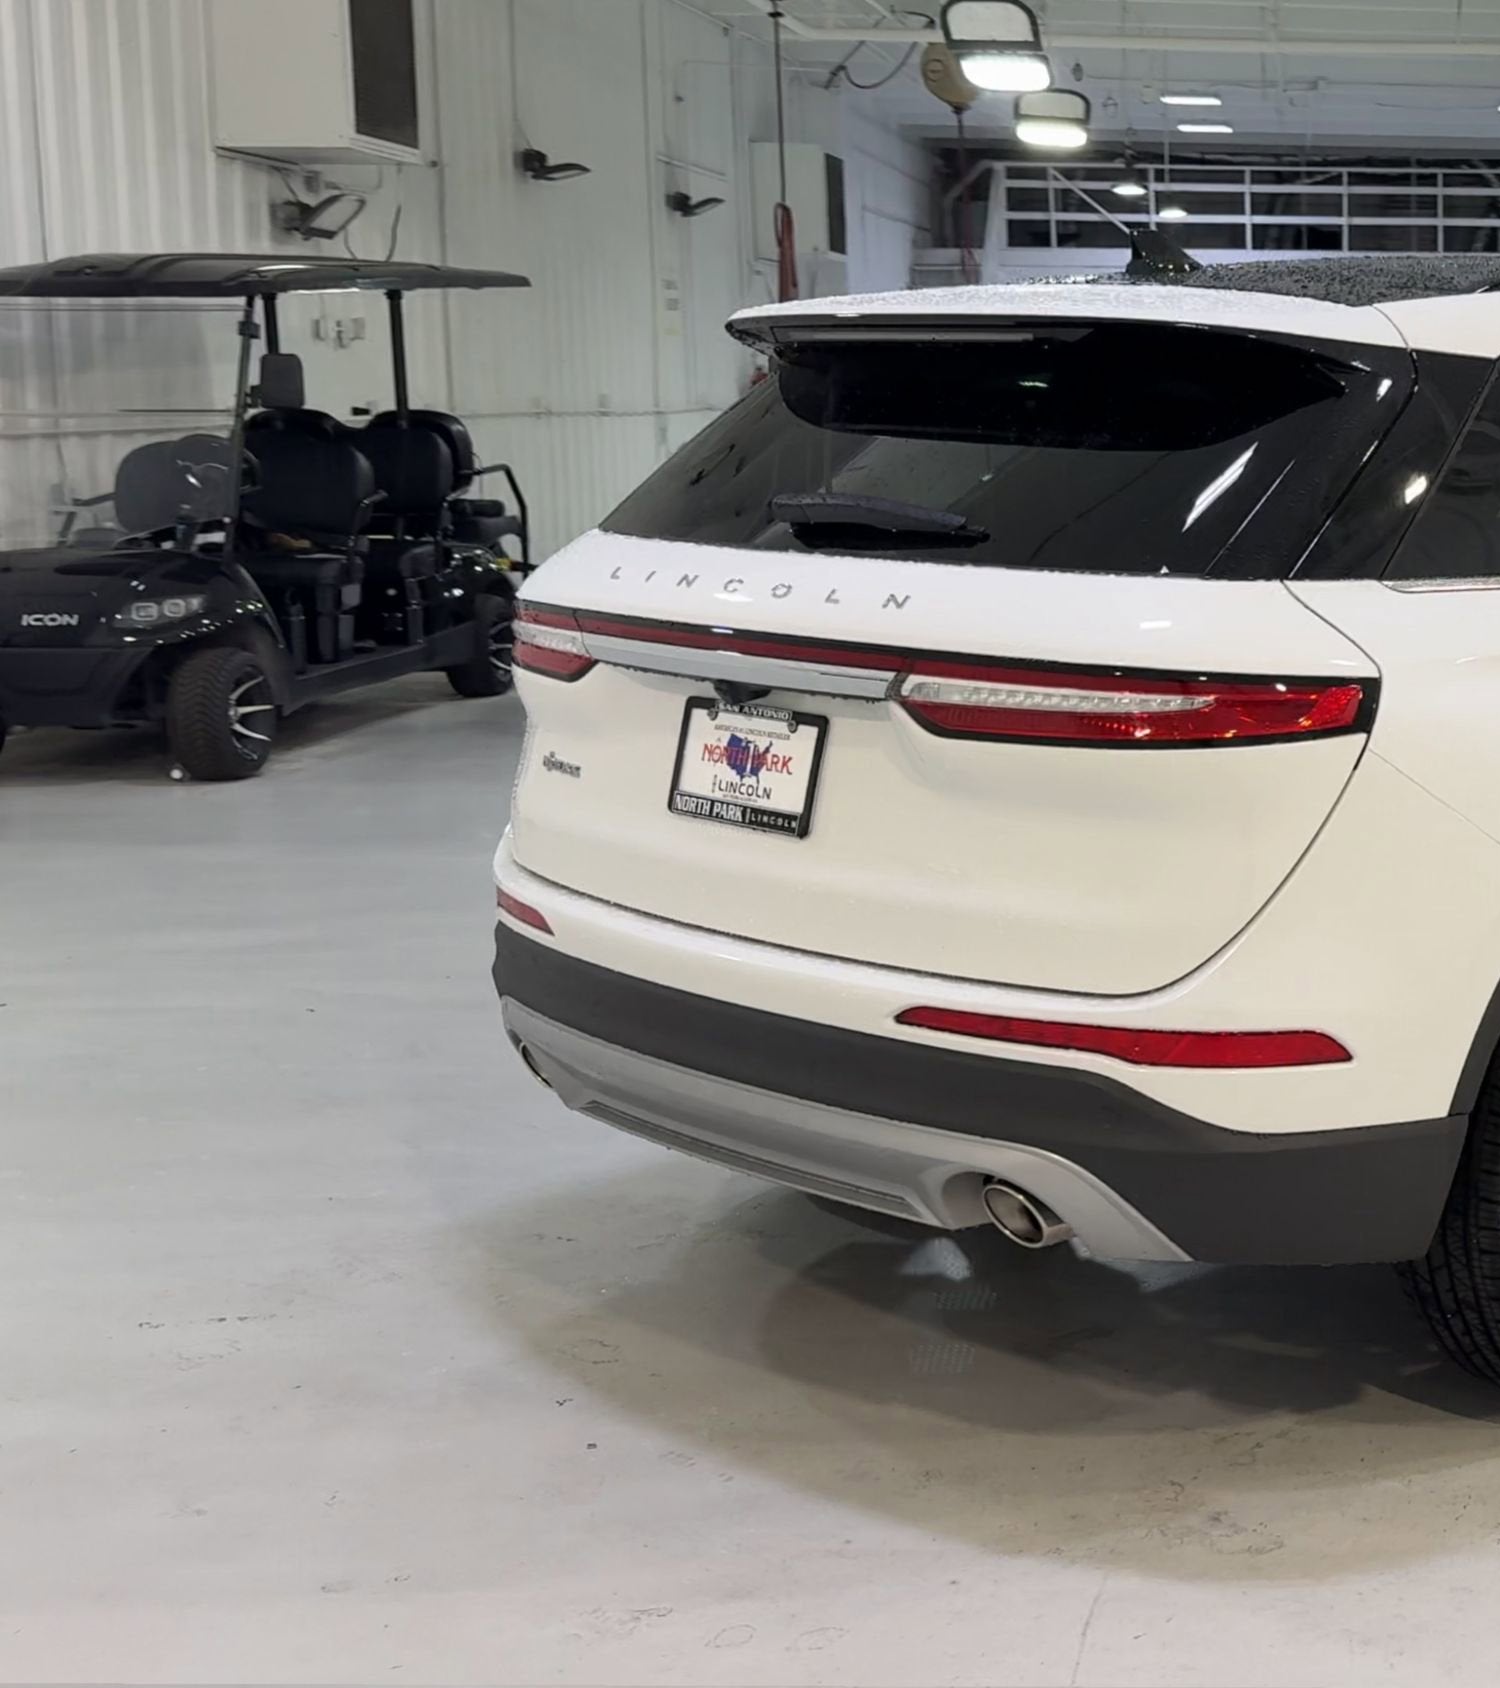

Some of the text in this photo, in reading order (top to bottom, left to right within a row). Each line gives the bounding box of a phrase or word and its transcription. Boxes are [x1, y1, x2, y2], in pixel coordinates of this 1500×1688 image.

[610, 566, 911, 609] LINCOLN
[21, 613, 79, 626] ICON
[742, 706, 789, 719] ANTONIO
[701, 743, 793, 775] NORTH PARK
[718, 779, 772, 800] LINCOLN
[674, 794, 711, 816] NORTH
[712, 801, 743, 822] PARK
[751, 813, 797, 829] LINCOLN
